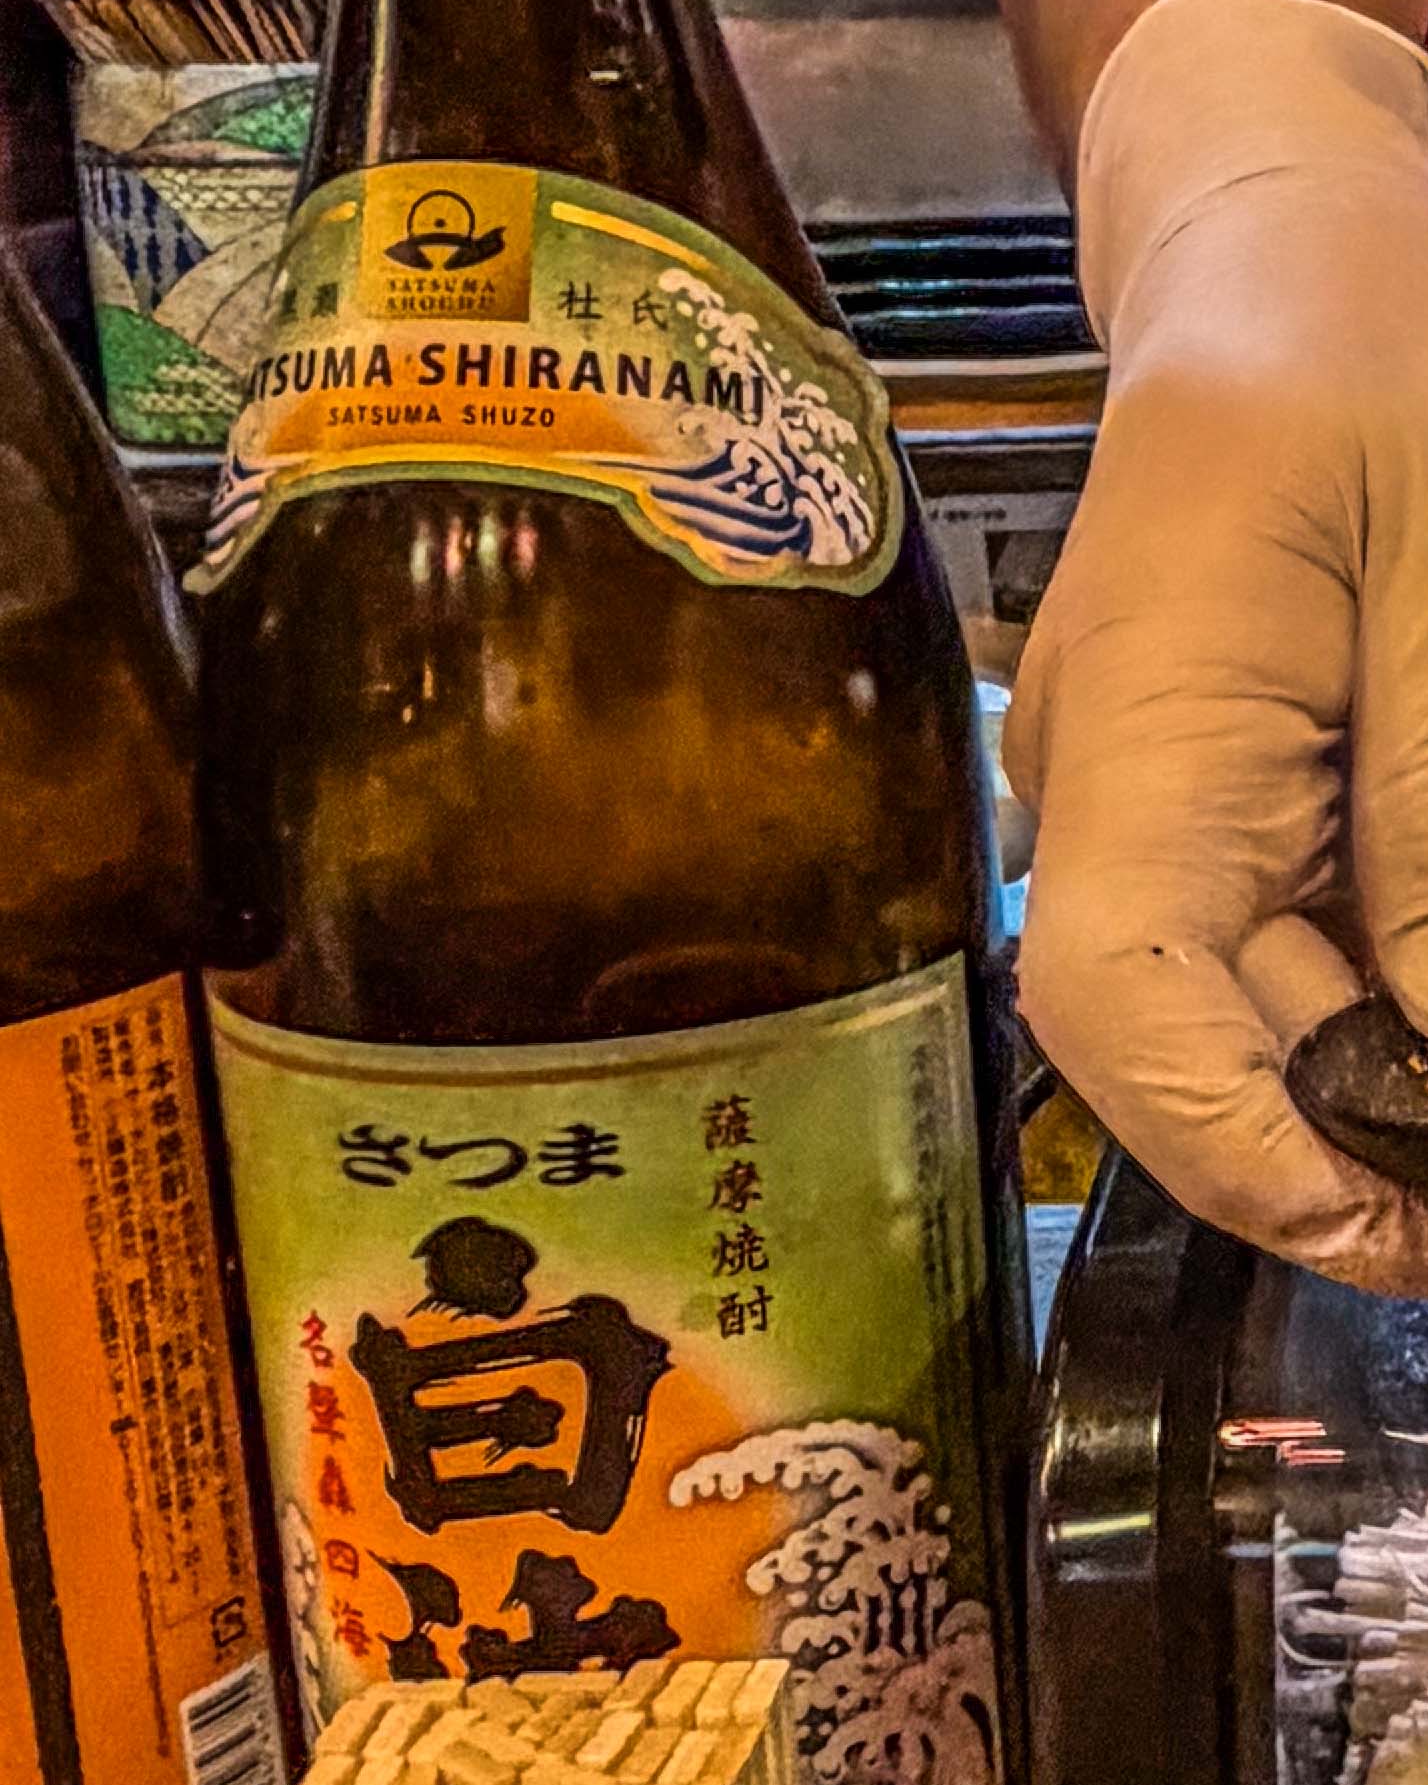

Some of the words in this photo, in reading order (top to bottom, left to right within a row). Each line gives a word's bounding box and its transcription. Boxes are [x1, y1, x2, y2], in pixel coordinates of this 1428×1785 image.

[327, 403, 442, 426] SATSUMA
[462, 404, 555, 428] SHUZO
[418, 342, 765, 424] SHIRANAMI
[337, 1122, 627, 1190] さつま
